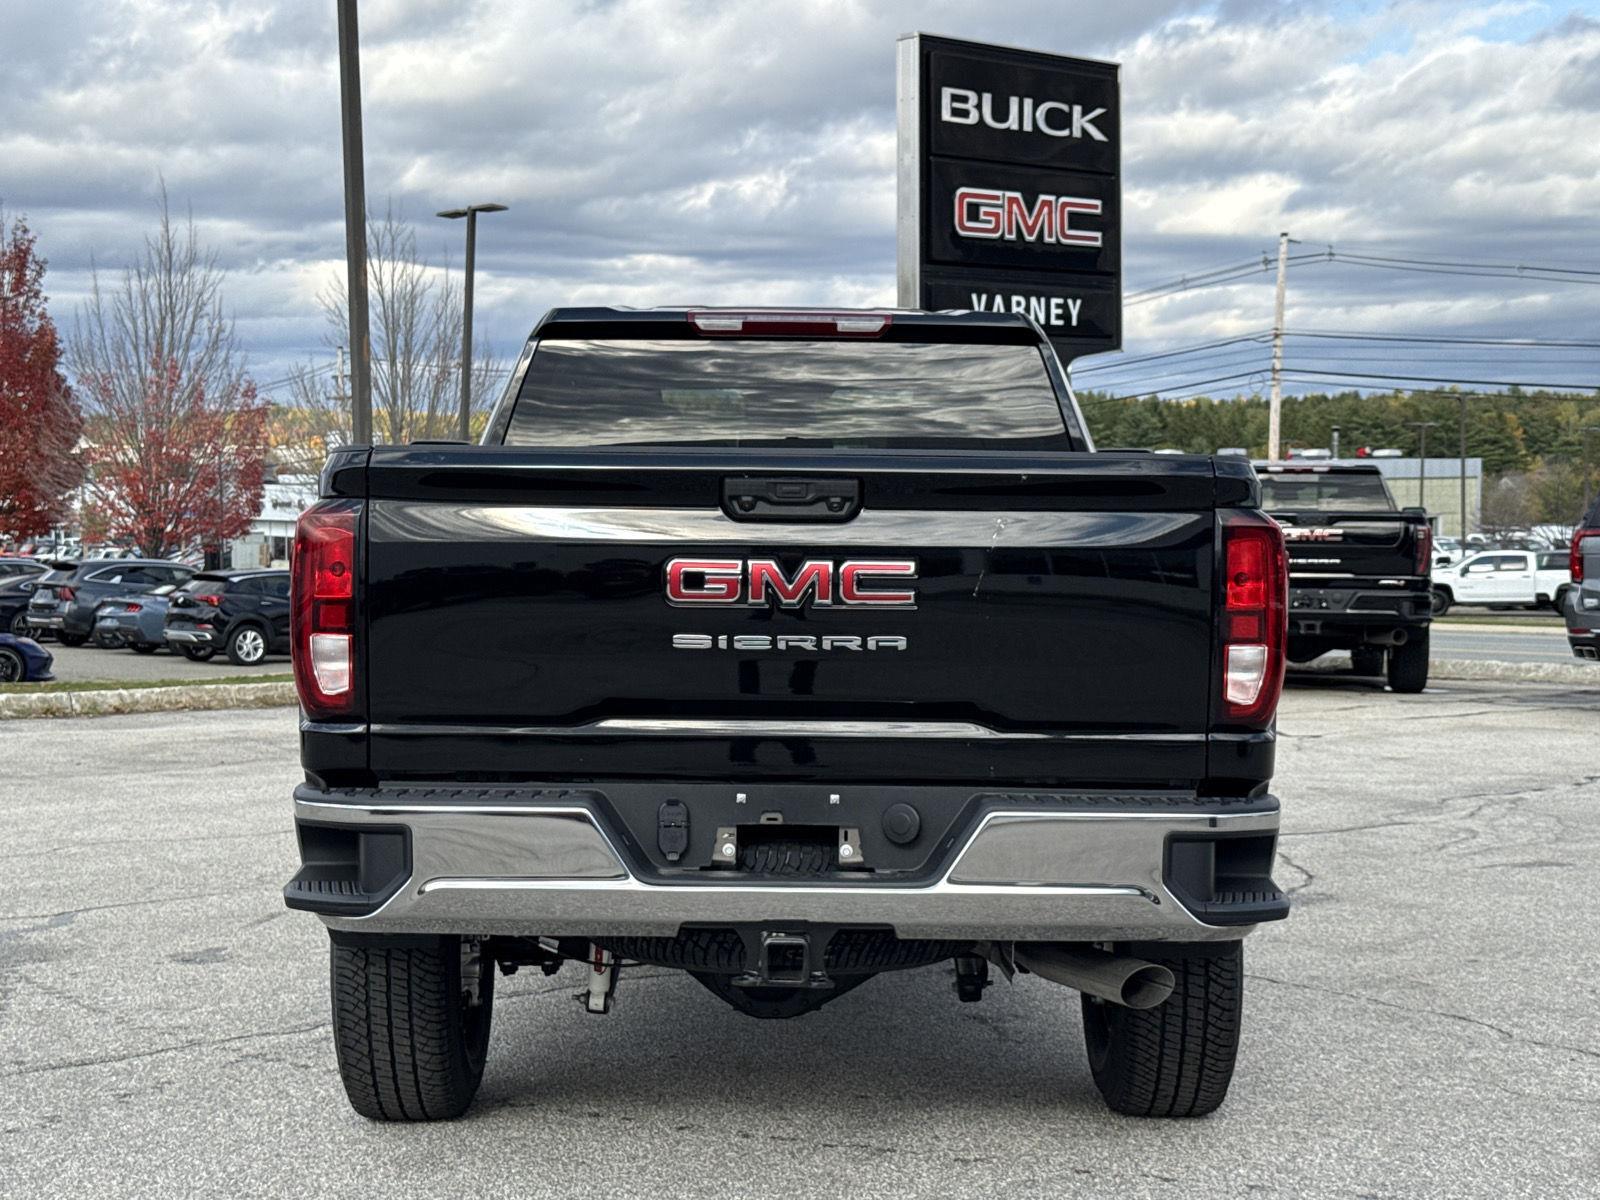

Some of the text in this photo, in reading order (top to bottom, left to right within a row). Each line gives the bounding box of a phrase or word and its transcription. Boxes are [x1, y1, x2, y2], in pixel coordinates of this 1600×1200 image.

[941, 86, 1109, 142] BUICK
[954, 186, 1103, 248] GMC
[971, 293, 1082, 327] VARNEY
[664, 556, 918, 609] GMC
[672, 634, 907, 651] SIERRA
